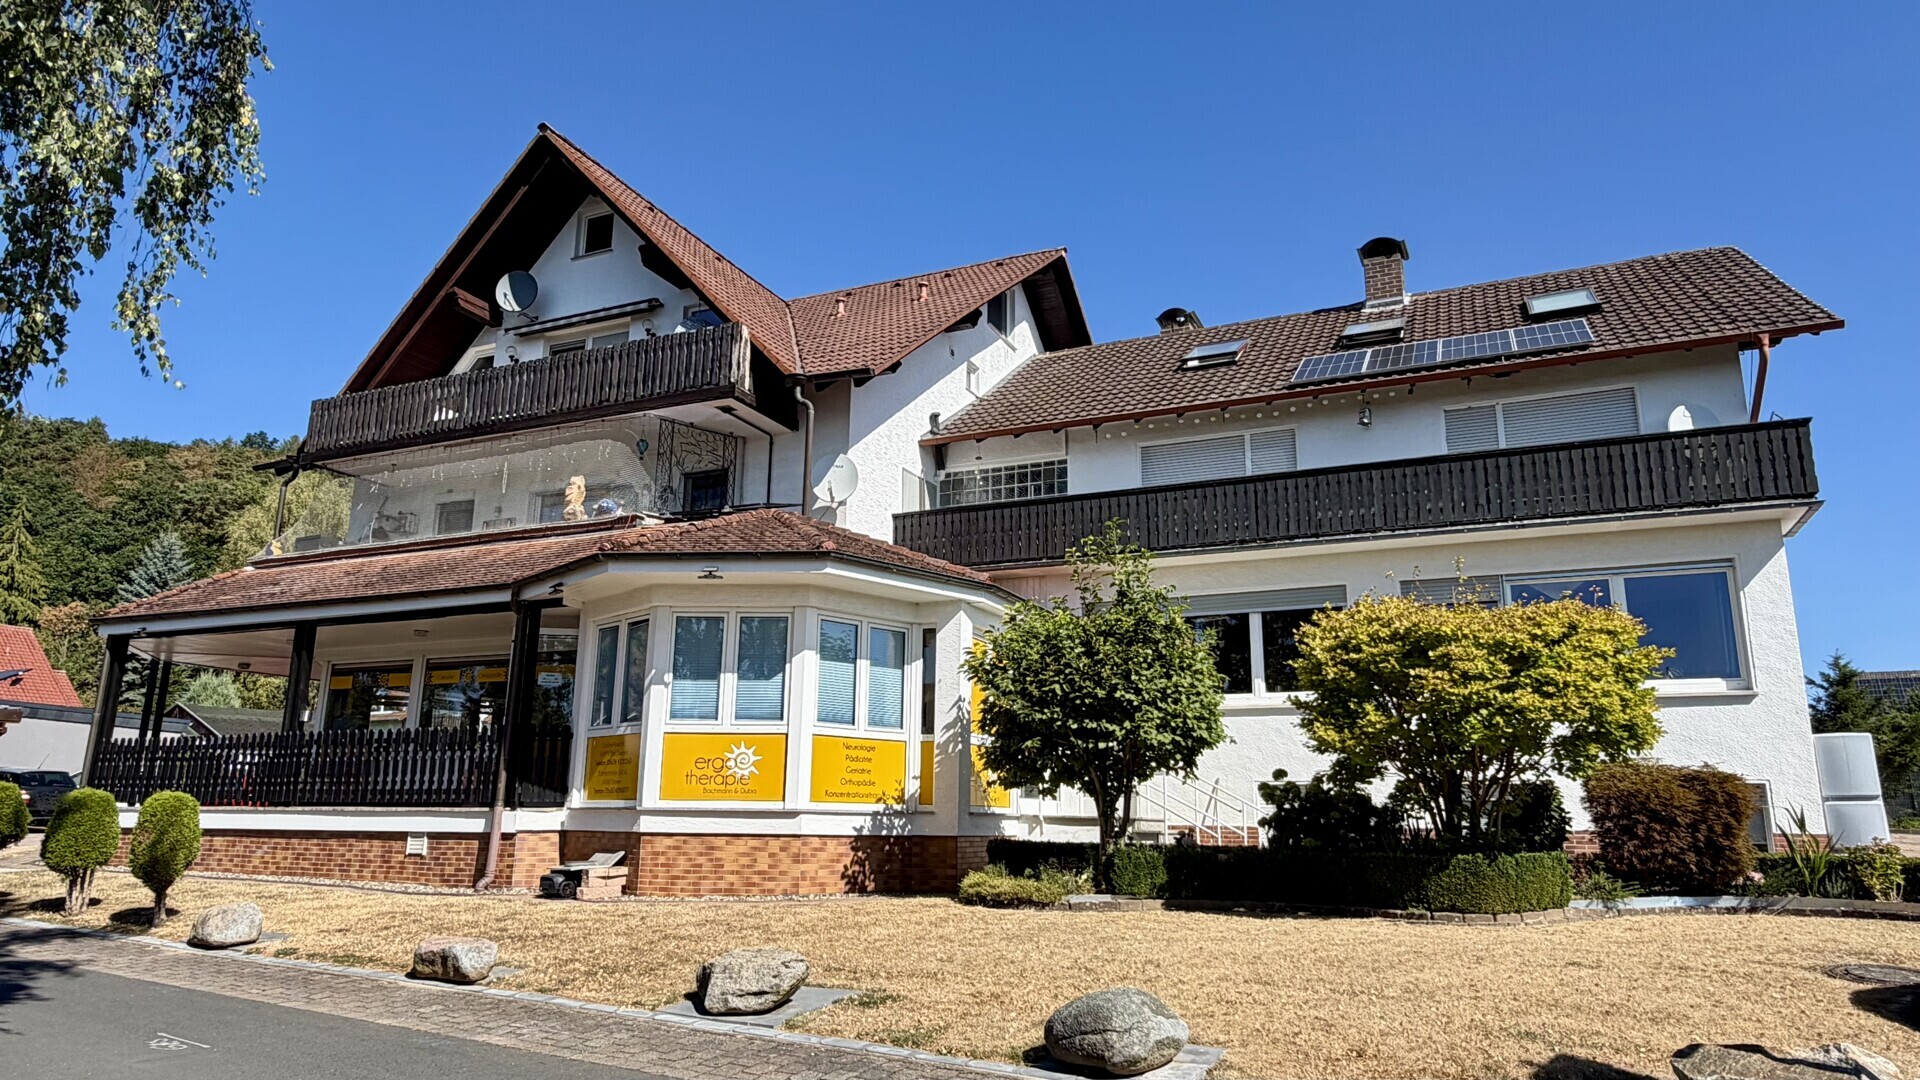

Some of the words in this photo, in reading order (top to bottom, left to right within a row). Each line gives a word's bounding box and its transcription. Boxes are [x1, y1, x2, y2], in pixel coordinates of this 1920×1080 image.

[842, 742, 876, 753] Neurologie
[845, 754, 873, 764] Pädiatrie
[694, 757, 738, 773] ergo
[845, 766, 872, 776] Geriatrie
[685, 769, 751, 788] therapie
[840, 777, 876, 787] Orthopädie
